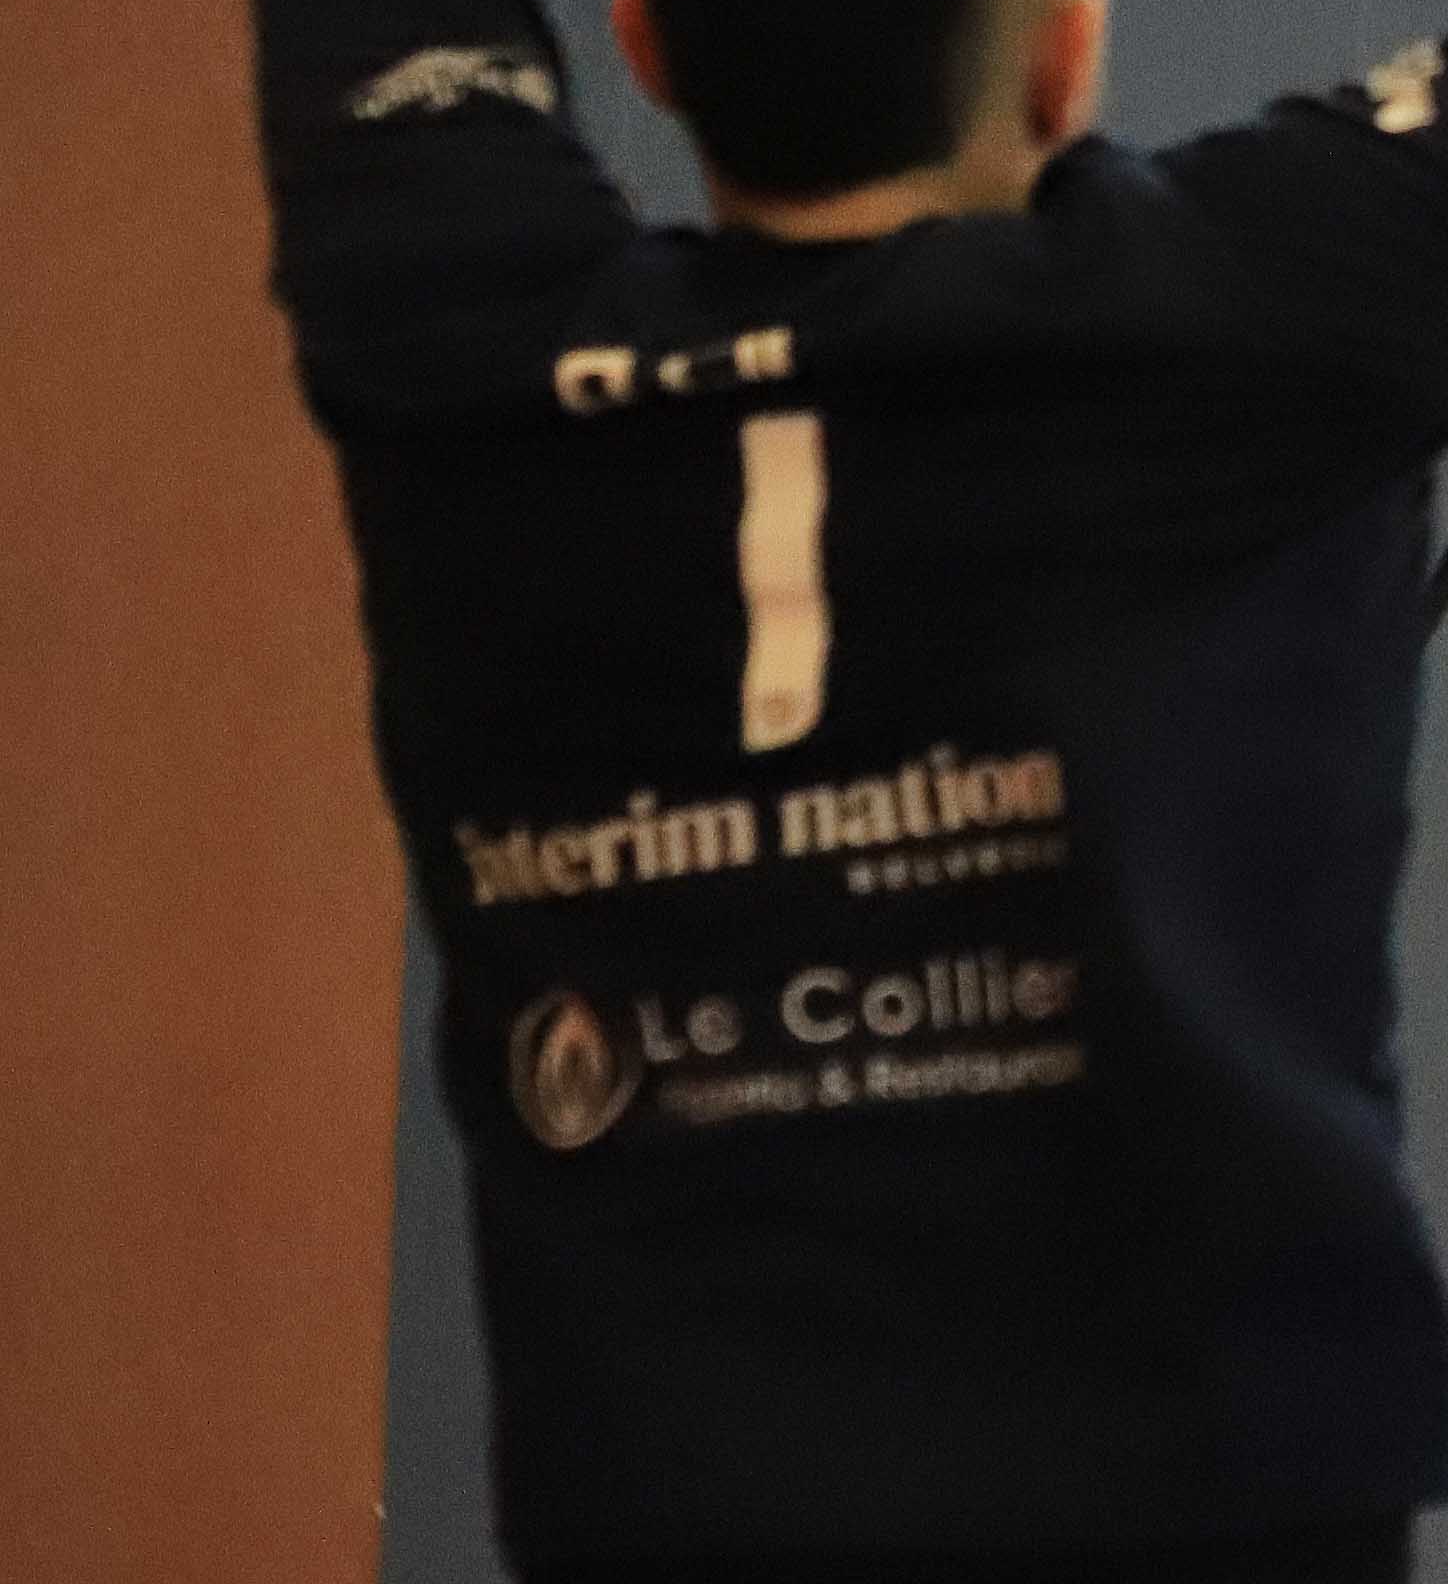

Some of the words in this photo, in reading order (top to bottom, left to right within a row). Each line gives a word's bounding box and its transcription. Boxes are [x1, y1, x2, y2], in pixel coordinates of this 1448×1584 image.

[736, 410, 832, 755] 1
[778, 740, 1064, 858] nation
[636, 994, 743, 1064] Le
